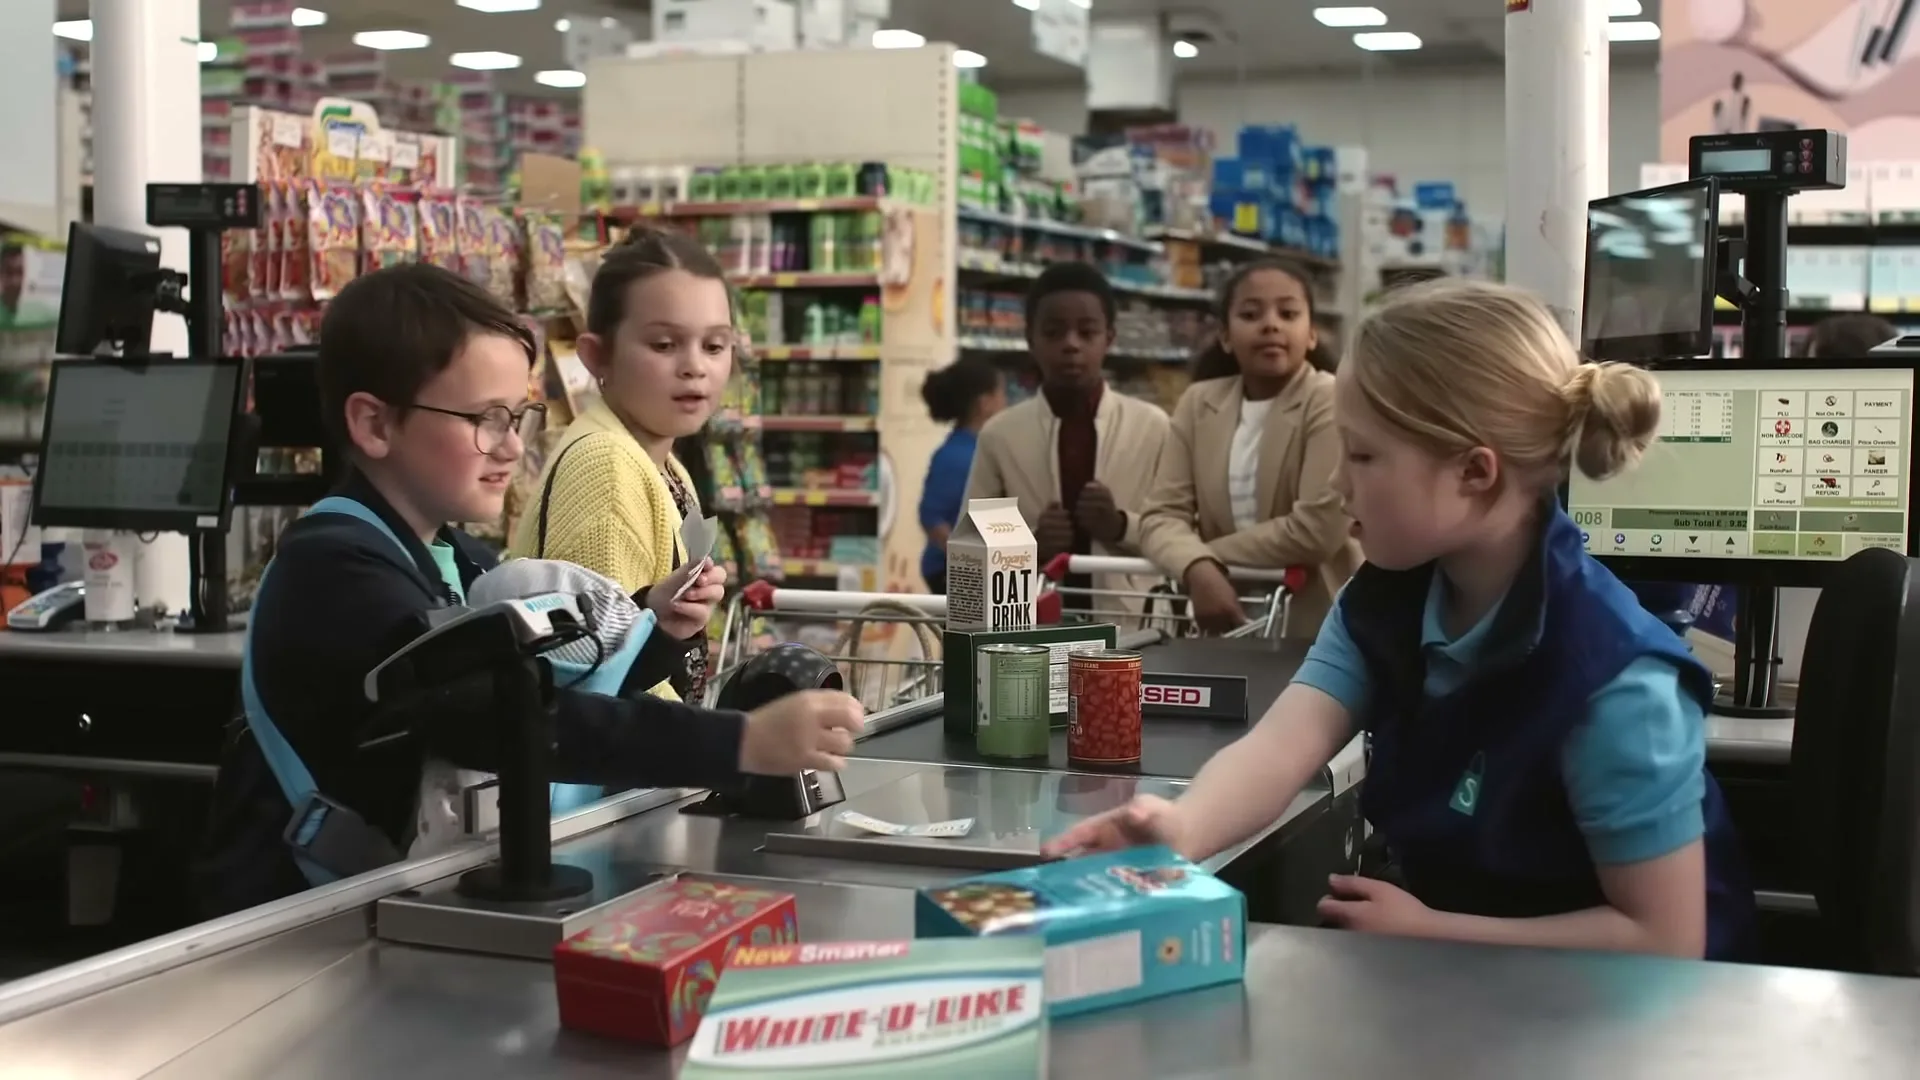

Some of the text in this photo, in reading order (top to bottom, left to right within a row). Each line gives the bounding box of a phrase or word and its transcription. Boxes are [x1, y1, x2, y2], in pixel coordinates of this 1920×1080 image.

[1574, 511, 1603, 525] 008
[1674, 519, 1691, 528] Sub
[1693, 519, 1715, 528] Total
[1729, 520, 1748, 528] 9.82
[991, 550, 1031, 571] Organic
[992, 569, 1031, 605] OAT
[992, 603, 1031, 627] DRINK
[1143, 687, 1201, 705] SED
[1458, 777, 1478, 808] S
[733, 941, 905, 967] New Smarter
